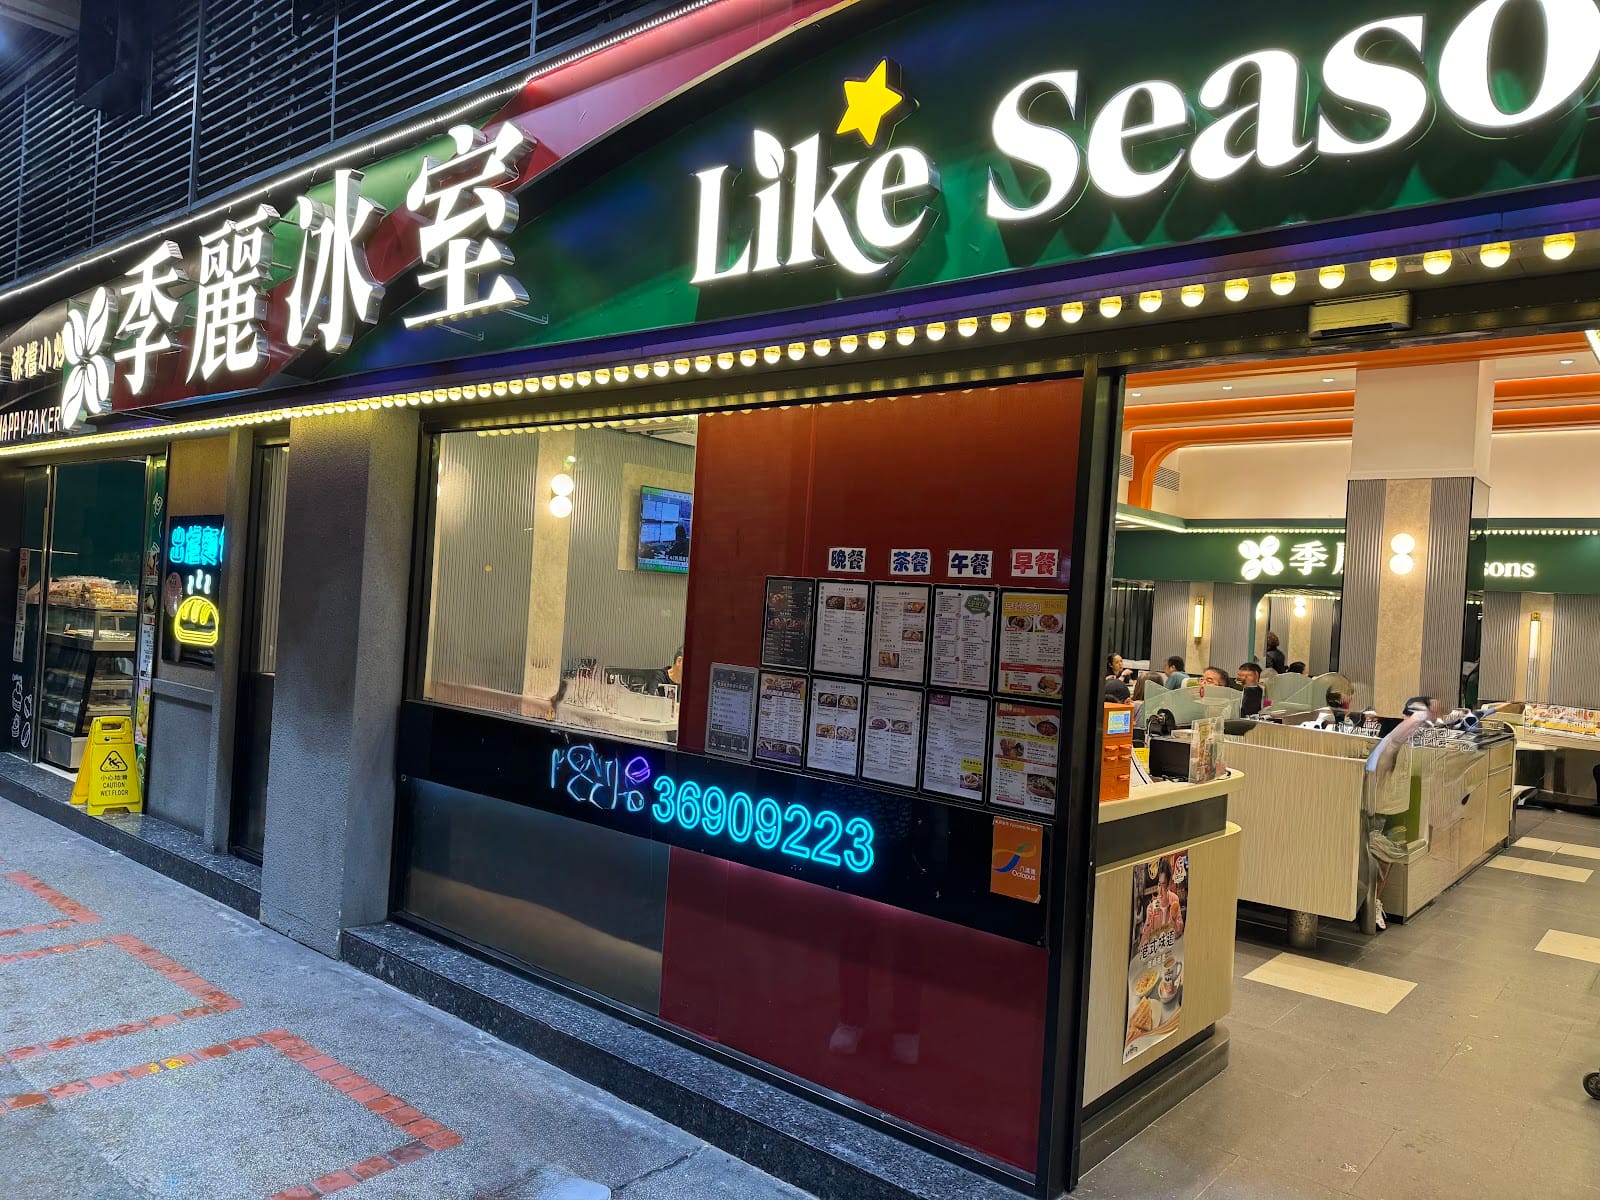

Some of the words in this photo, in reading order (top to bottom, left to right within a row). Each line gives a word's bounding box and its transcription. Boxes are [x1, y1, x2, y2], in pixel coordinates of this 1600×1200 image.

[690, 126, 940, 286] Like
[114, 121, 524, 395] 季麗冰室
[170, 525, 225, 566] 出爐麵
[830, 549, 865, 571] 晚餐
[893, 551, 928, 573] 茶餐
[1289, 540, 1345, 575] 季
[950, 552, 990, 575] 午餐
[1013, 551, 1054, 576] 早餐
[651, 774, 875, 873] 36909223
